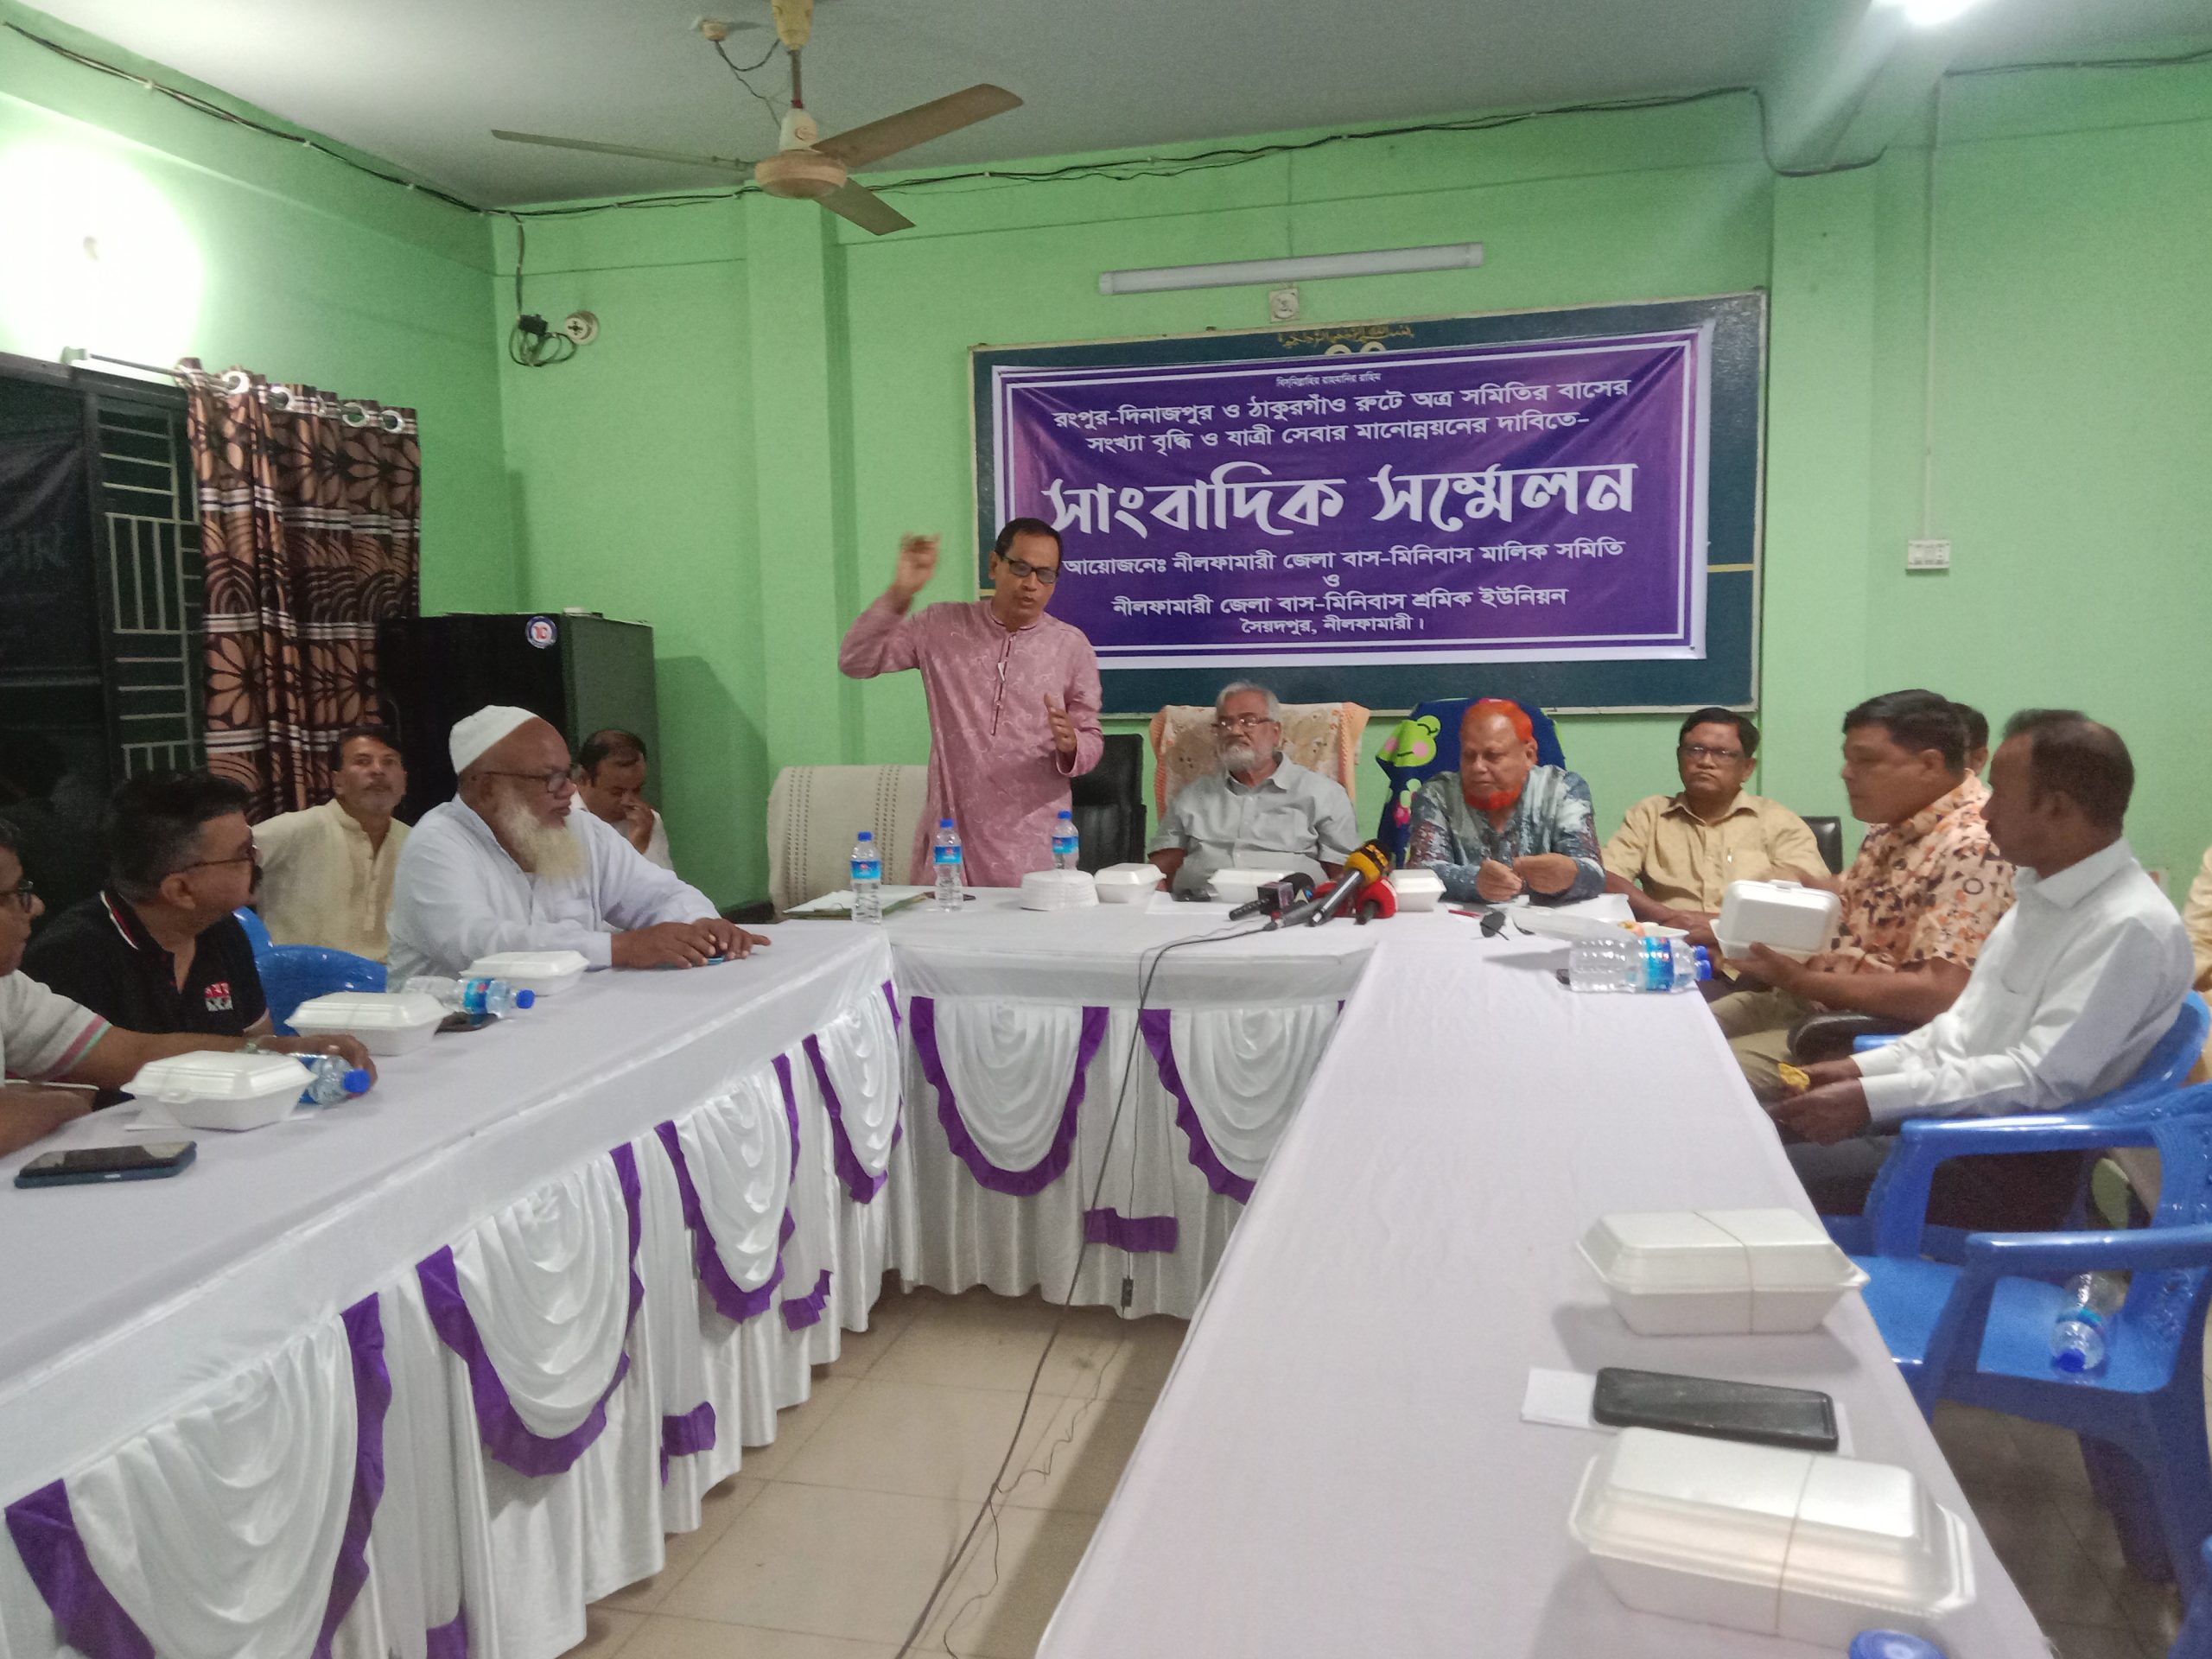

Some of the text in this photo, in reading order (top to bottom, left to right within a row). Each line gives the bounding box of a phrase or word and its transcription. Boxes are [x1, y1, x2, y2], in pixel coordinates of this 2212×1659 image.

[1052, 379, 1631, 429] রংপুর-দিনাজপুর ও ঠাকুরগাঁও রুটে অত্র সমিতির বাসের
[1084, 432, 1146, 454] সংখ্যা
[1149, 429, 1194, 456] বৃদ্ধি
[1200, 433, 1218, 447] ও
[1224, 423, 1275, 447] যাত্রী
[1281, 424, 1349, 443] সেবার
[1353, 417, 1491, 440] মানোন্নয়নের
[1040, 461, 1347, 539] সাংবাদিক
[1061, 536, 1626, 575] আয়োজনেঃ নীলফামারী জেলা বাস-মিনিবাস মালিক সমিতি
[1110, 584, 1569, 617] নীলফামারী জেলা বাস-মিনিবাস শ্রমিক ইউনিয়ন
[1322, 574, 1340, 588] ও
